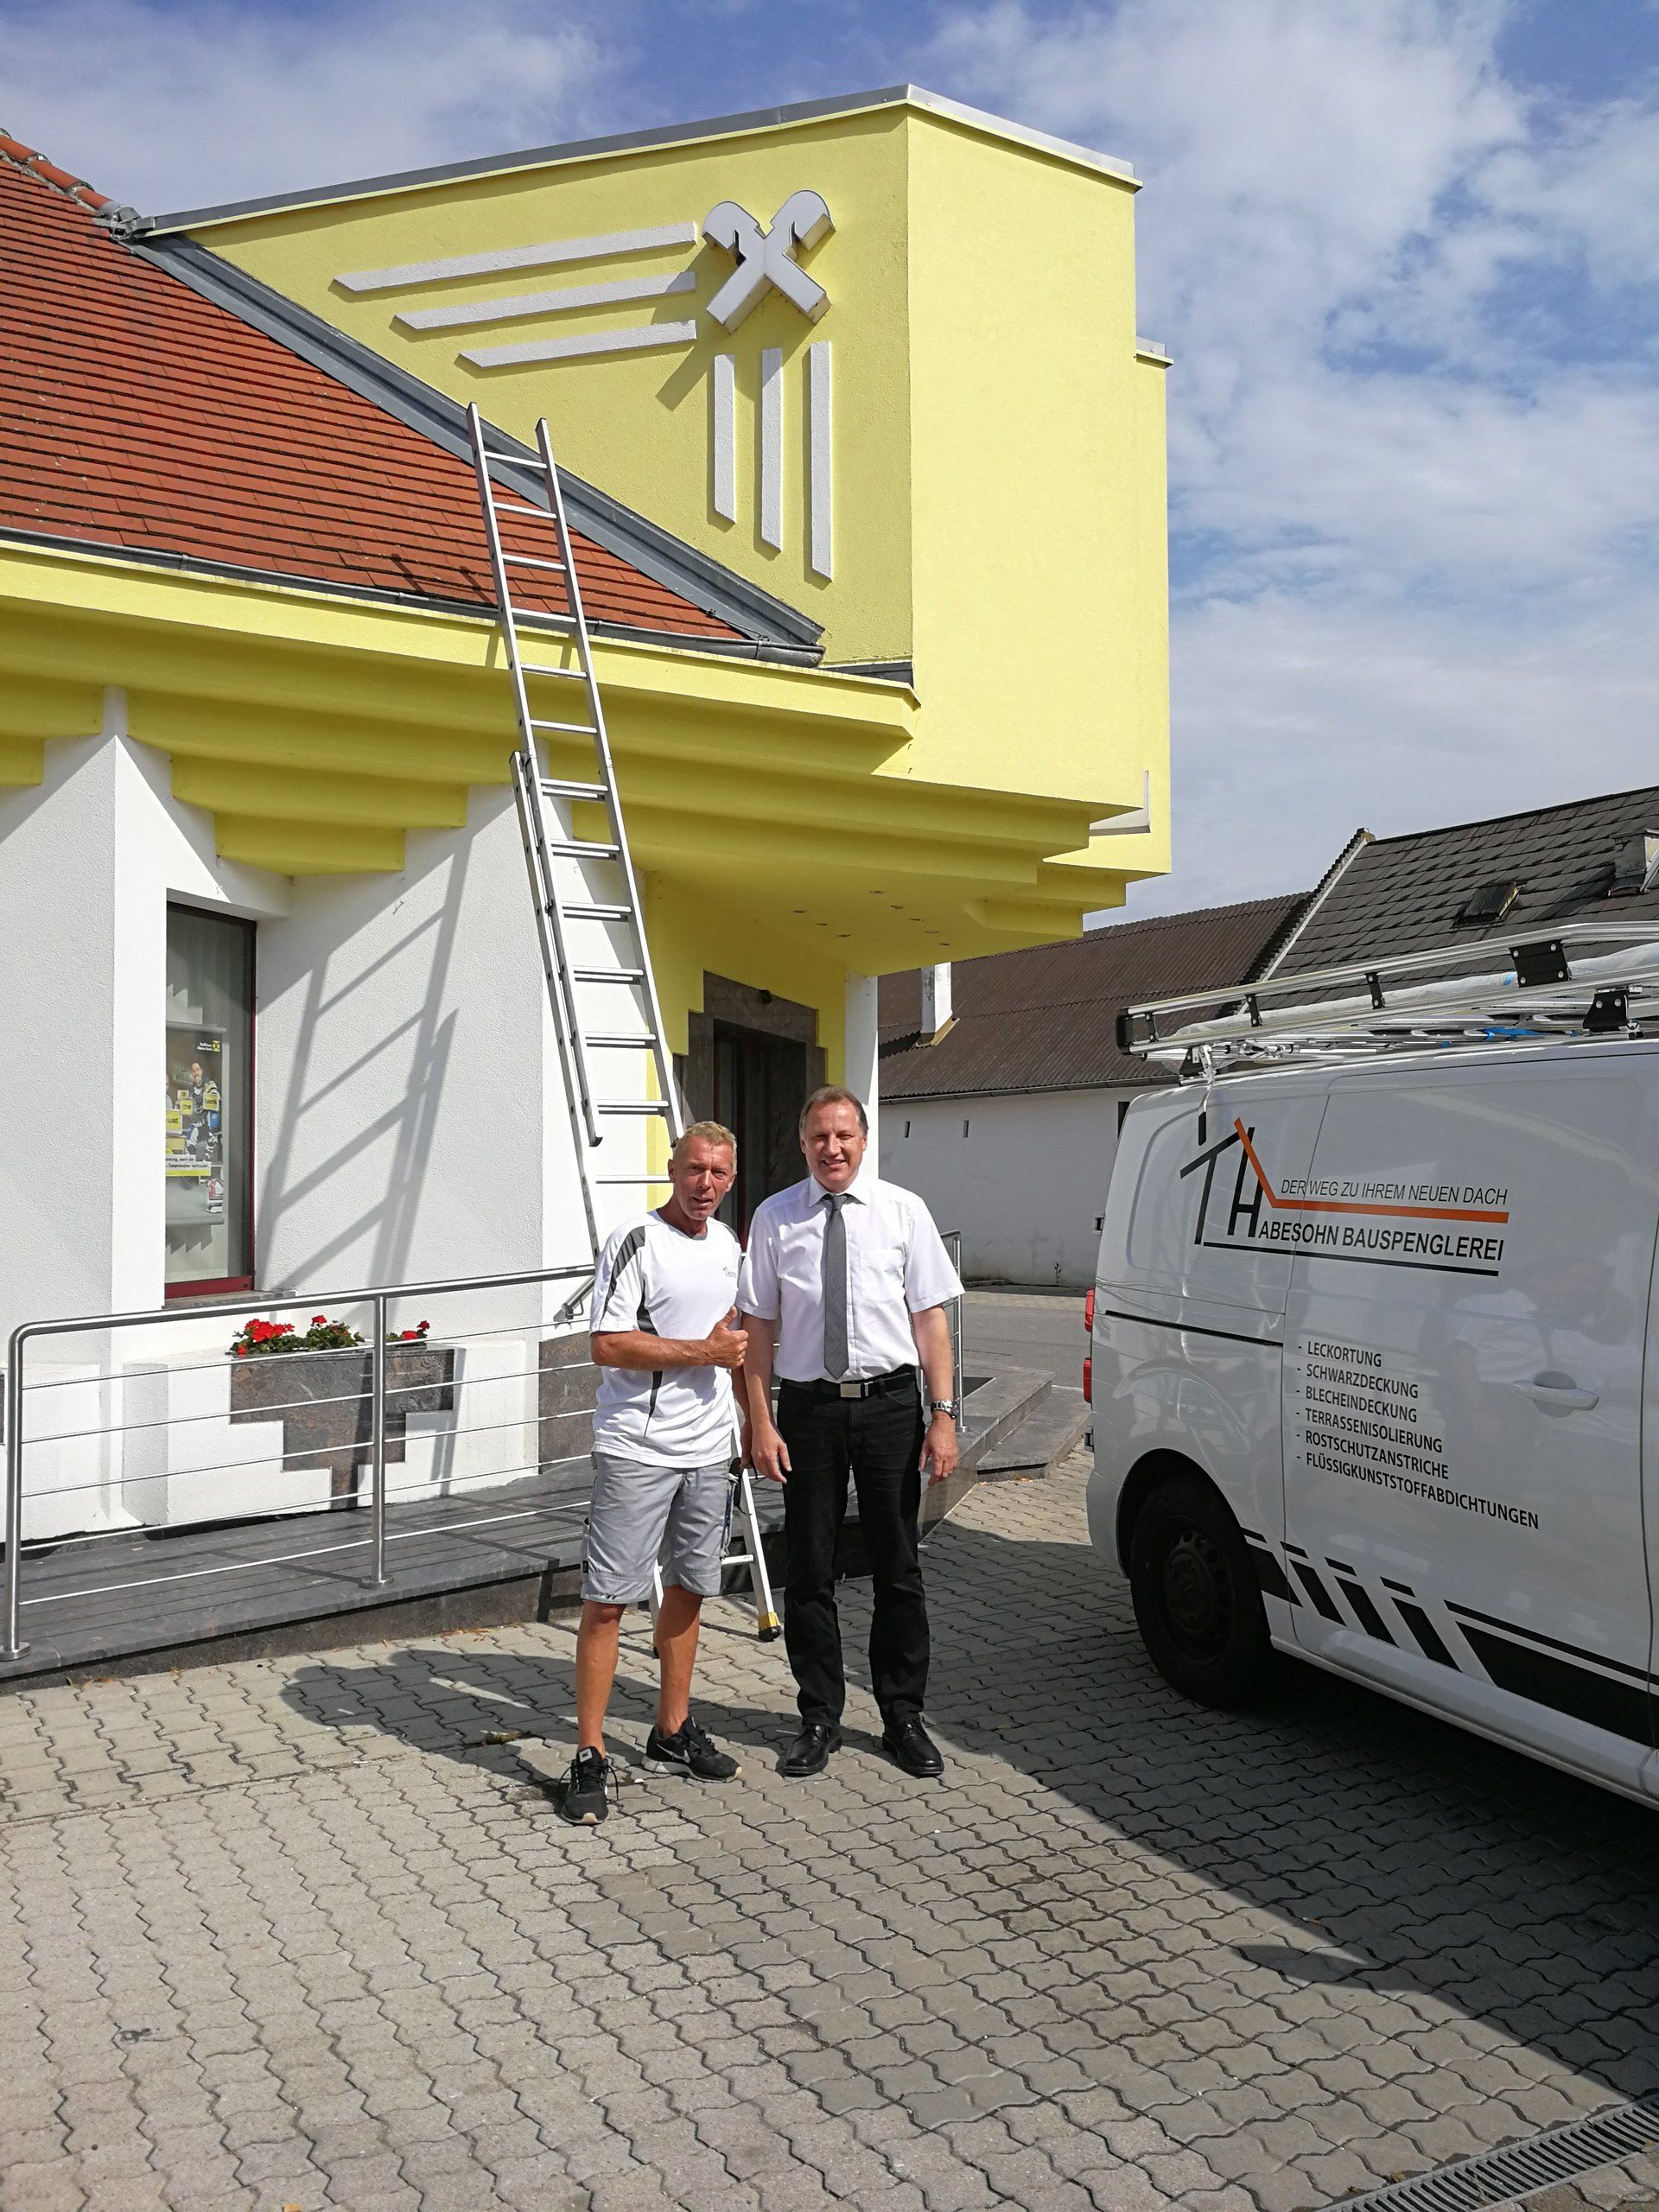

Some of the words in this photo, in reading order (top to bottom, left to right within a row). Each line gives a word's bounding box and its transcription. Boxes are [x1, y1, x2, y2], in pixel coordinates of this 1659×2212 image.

[1281, 1179, 1306, 1195] DER
[1309, 1180, 1338, 1197] WEG
[1338, 1182, 1360, 1198] ZU
[1362, 1183, 1408, 1201] IHREM
[1408, 1185, 1460, 1204] NEUEN
[1463, 1186, 1509, 1206] DACH
[1342, 1227, 1504, 1262] BAUSPENGLEREI
[1306, 1340, 1382, 1368] LECKORTUNG
[1306, 1363, 1419, 1399] SCHWARZDECKUNG
[1306, 1386, 1417, 1423] BLECHEINDECKUNG
[1305, 1408, 1443, 1453] TERRASSENISOLIERUNG
[1306, 1430, 1449, 1480] ROSTSCHUTZANSTRICHE
[1306, 1452, 1540, 1530] FLÜSSIGKUNSTSTOFFABDICHTUNGEN
